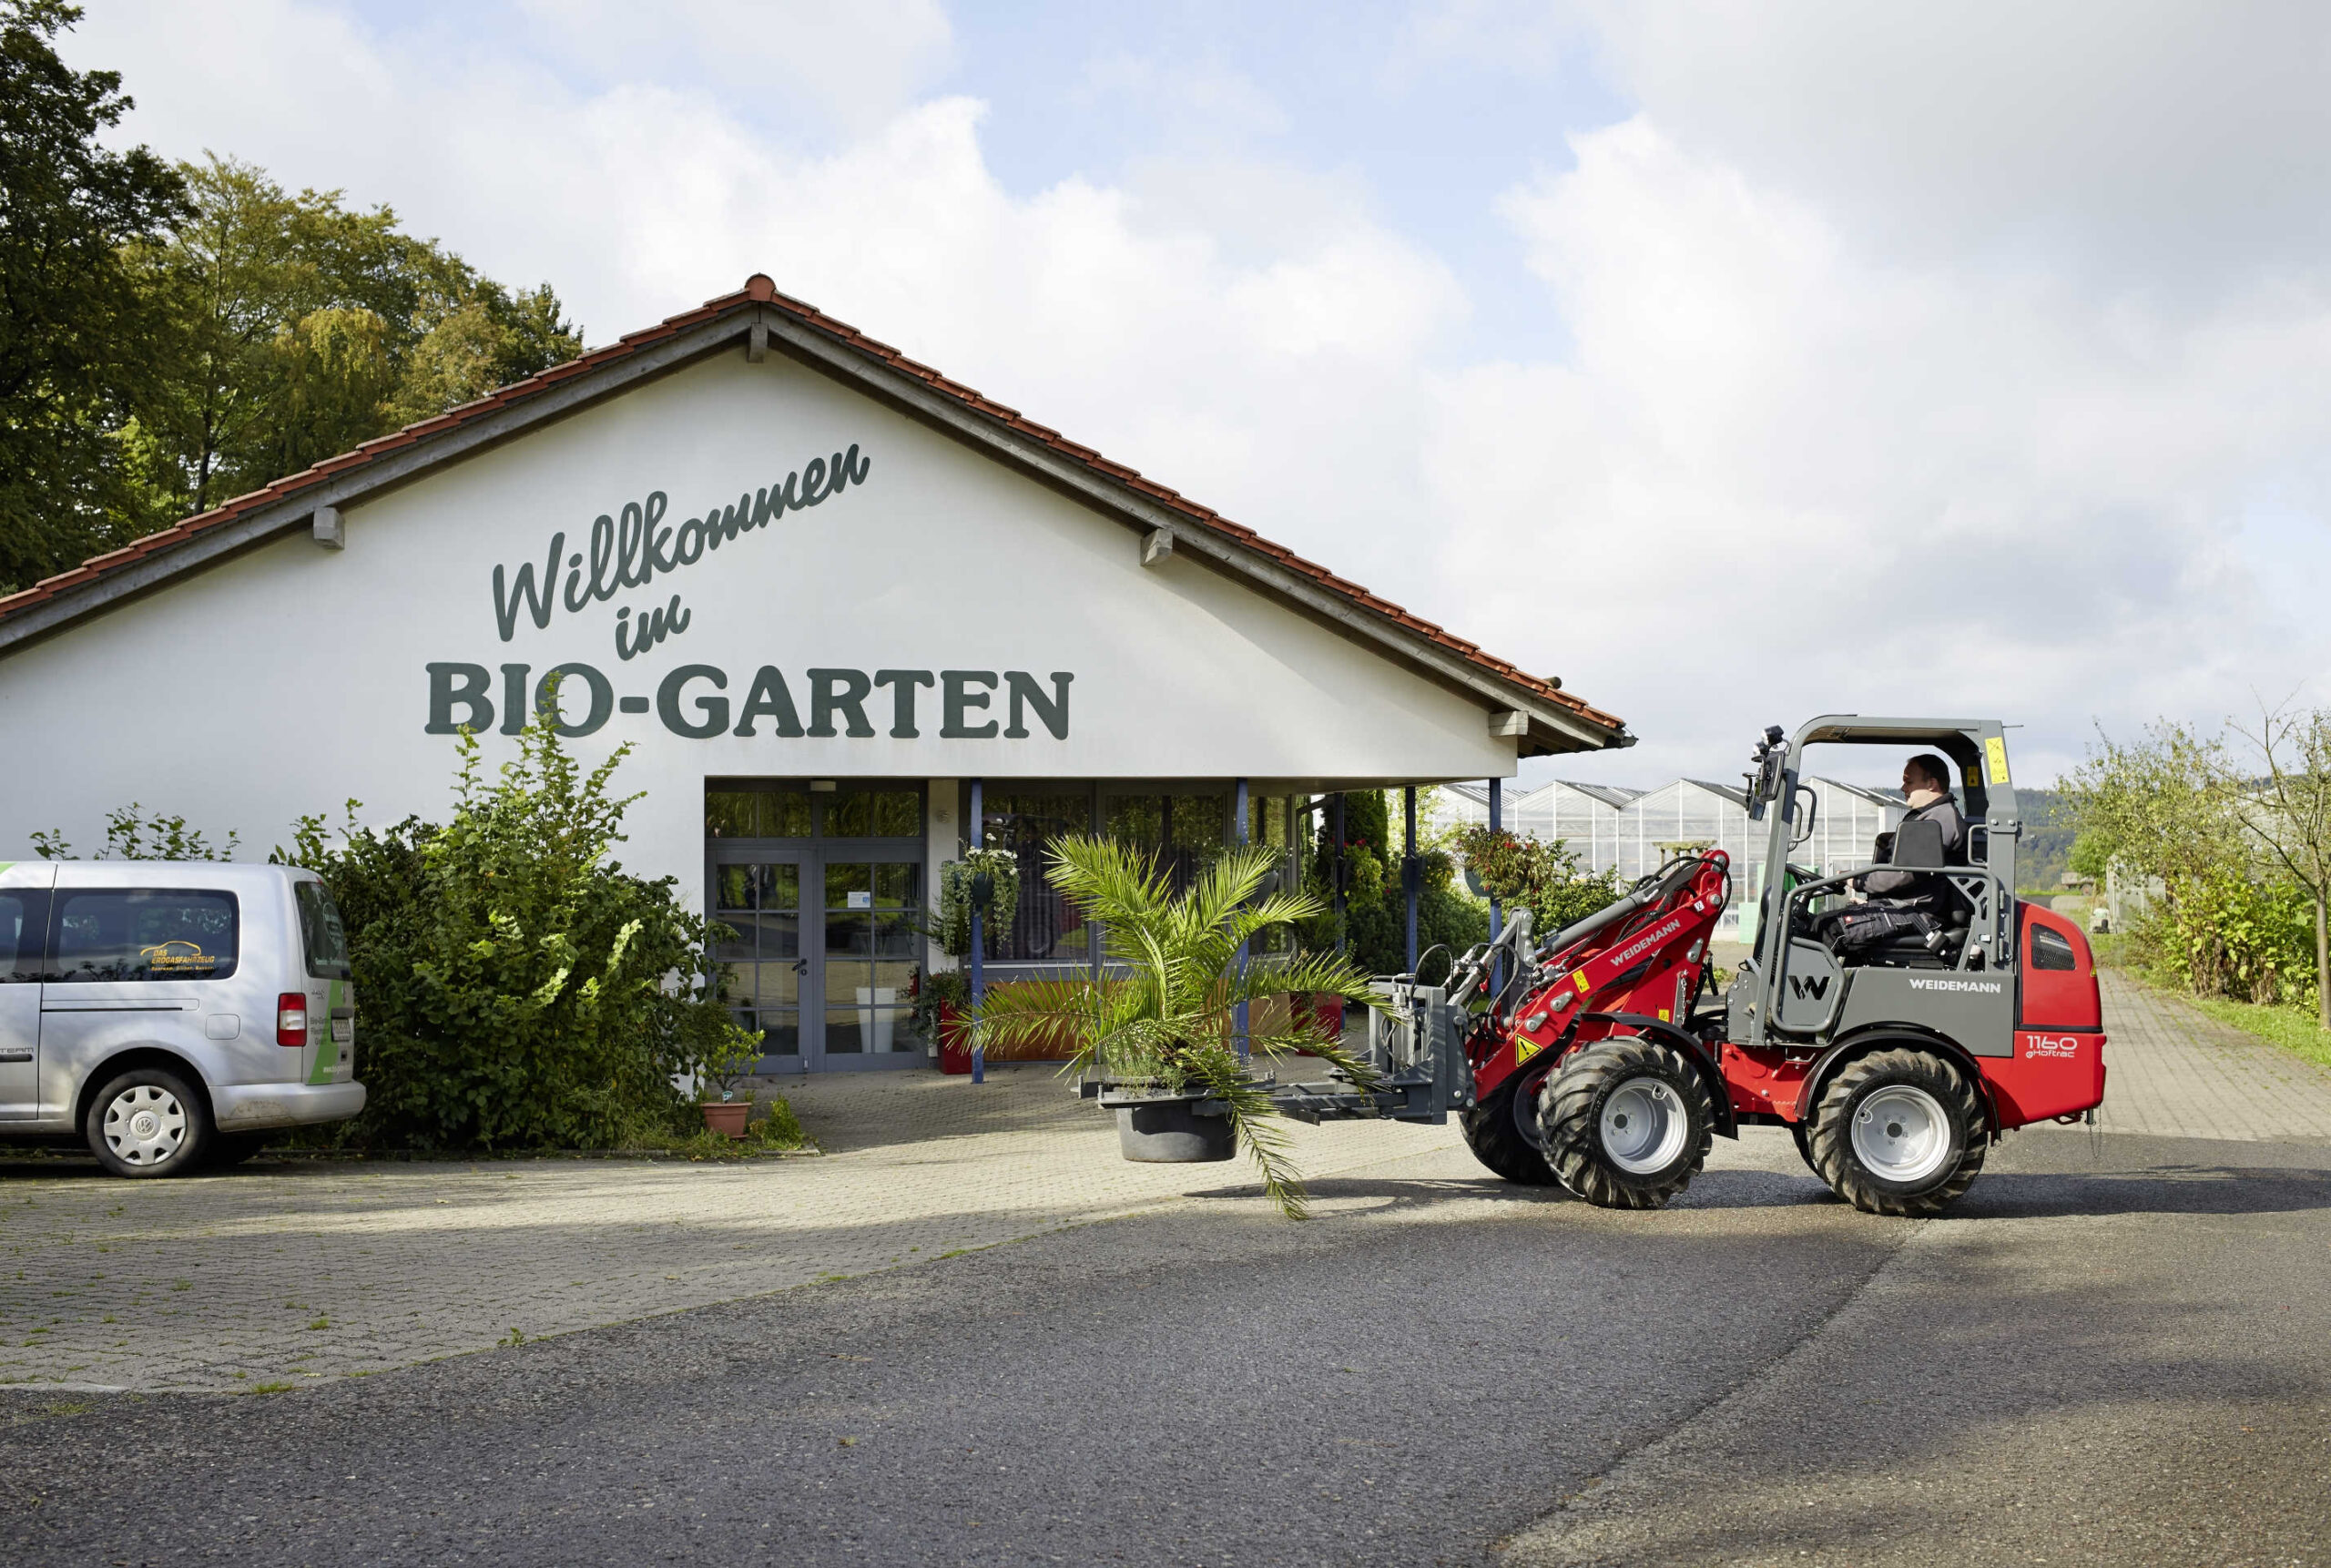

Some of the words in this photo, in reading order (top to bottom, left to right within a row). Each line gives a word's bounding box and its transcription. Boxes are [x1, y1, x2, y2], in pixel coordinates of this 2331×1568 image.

[492, 443, 870, 643] Willkommen
[615, 594, 692, 661] im
[423, 661, 1075, 741] BIO-GARTEN
[153, 949, 168, 957] DAS
[1610, 919, 1682, 967] WEIDEMANN
[151, 955, 215, 964] ERDGASFAHRZEUG
[1909, 978, 2001, 994] WEIDEMANN
[2026, 1034, 2078, 1051] 1160
